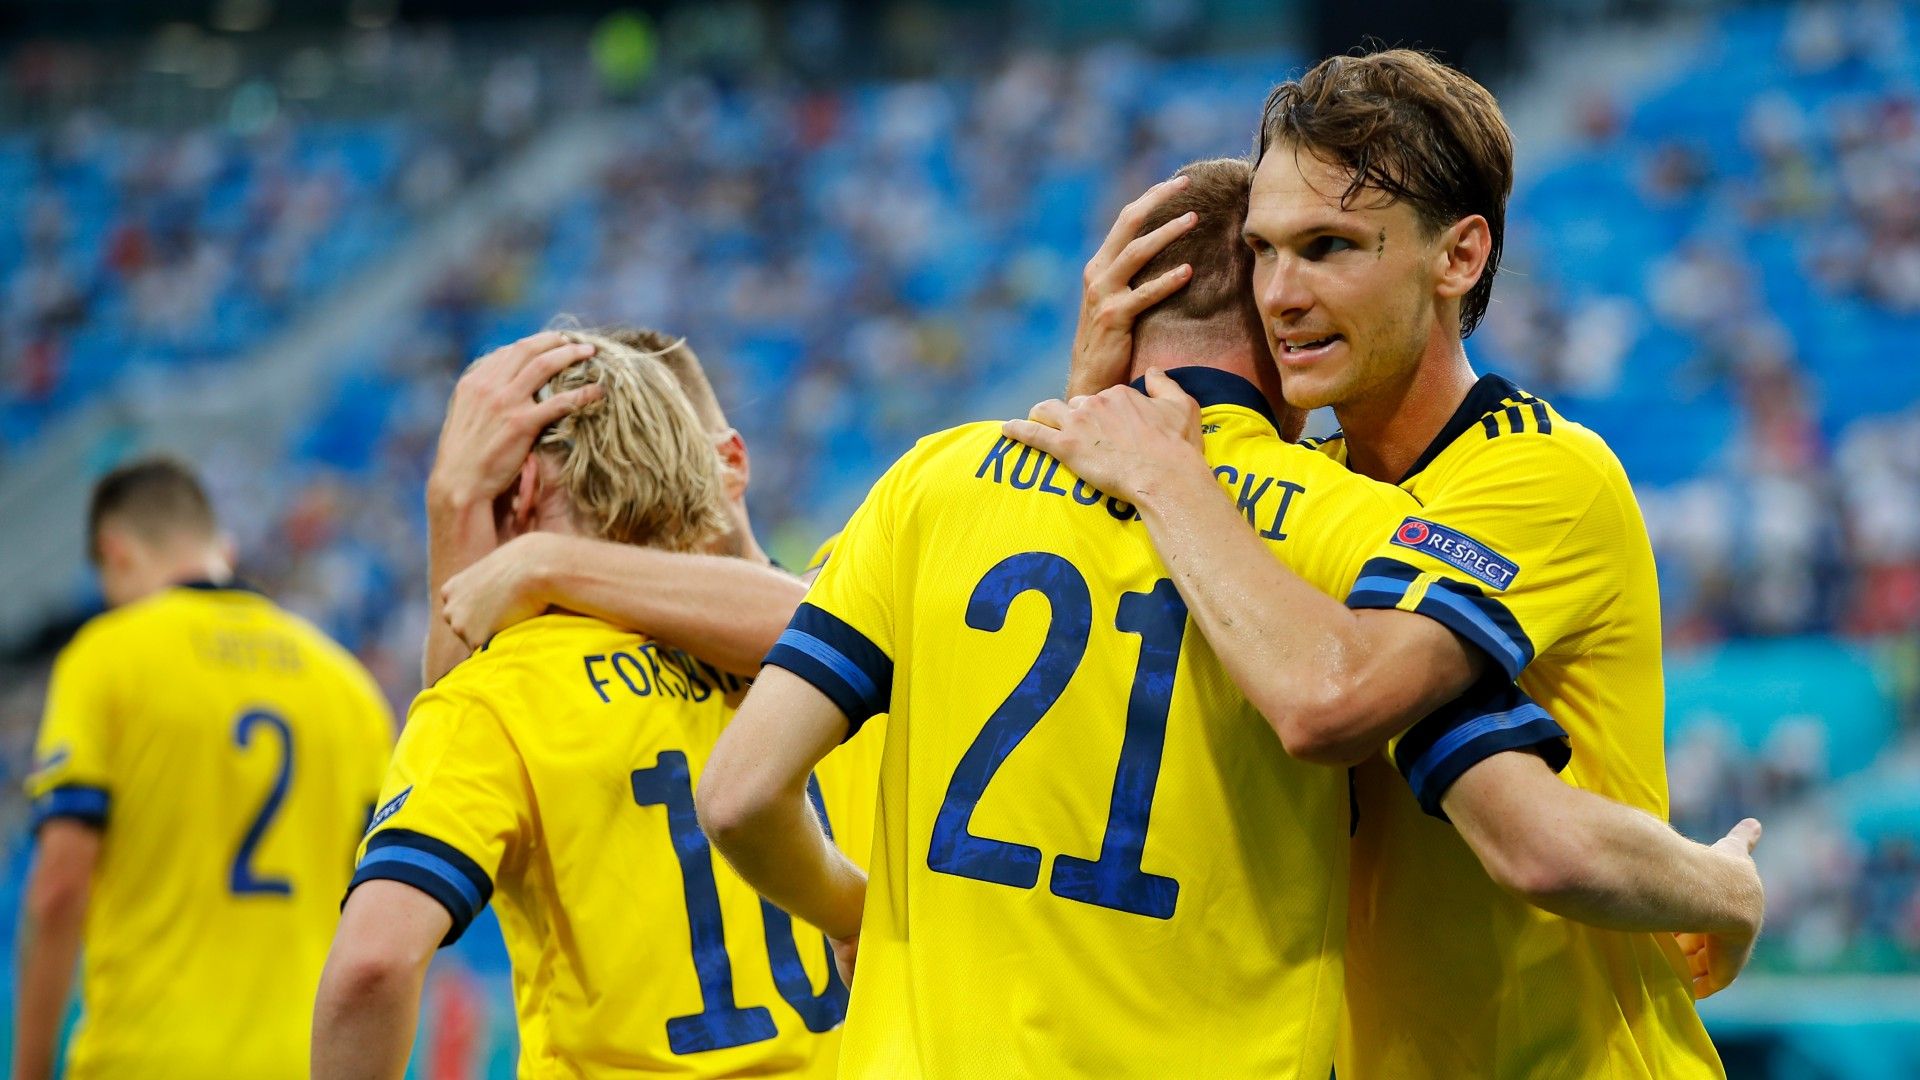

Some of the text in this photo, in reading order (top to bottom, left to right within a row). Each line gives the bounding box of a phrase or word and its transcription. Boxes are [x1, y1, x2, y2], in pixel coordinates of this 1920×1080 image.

[1429, 534, 1513, 583] RESPECT
[230, 706, 295, 894] 2
[927, 551, 1188, 920] 21
